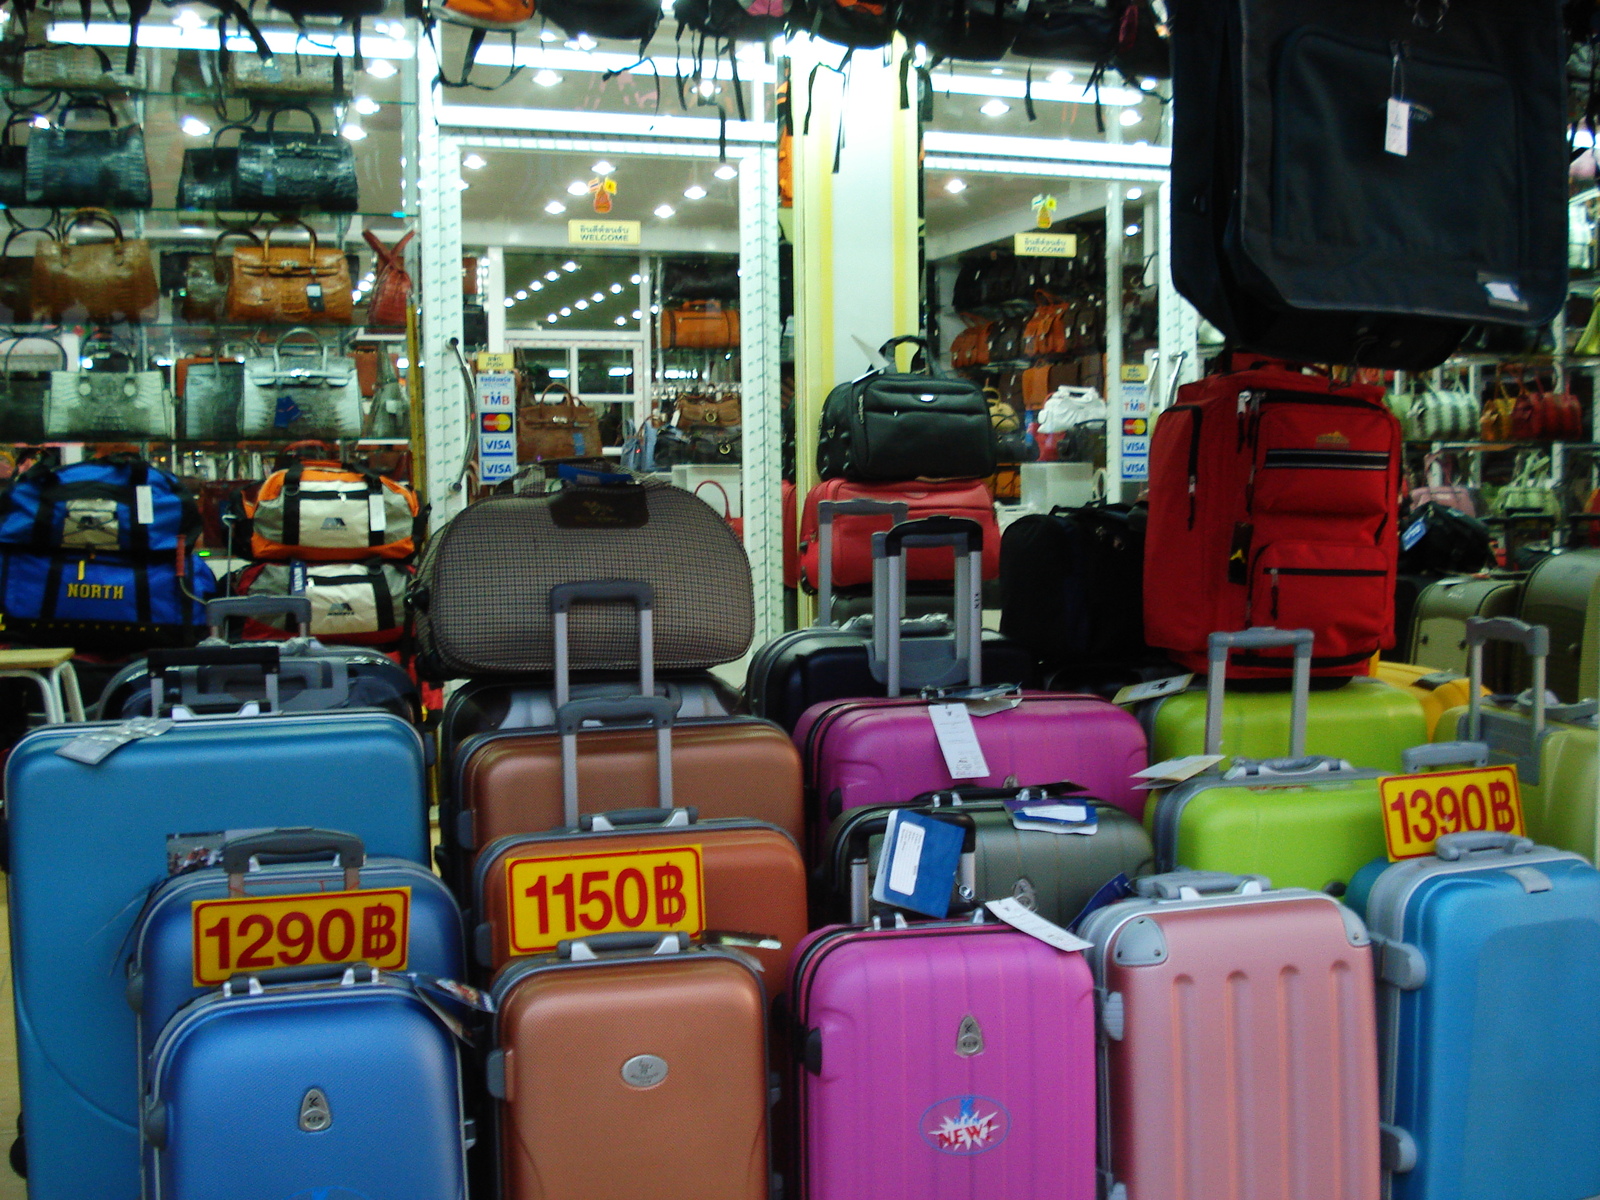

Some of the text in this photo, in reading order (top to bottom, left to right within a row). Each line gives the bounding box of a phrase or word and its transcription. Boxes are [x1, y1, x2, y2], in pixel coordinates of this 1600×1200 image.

[1025, 245, 1066, 253] WELCOME
[482, 395, 509, 405] TMB
[1124, 402, 1146, 411] TMB
[486, 440, 511, 449] VISA
[1126, 442, 1145, 451] VISA
[487, 464, 511, 474] VISA
[1126, 463, 1145, 472] VISA
[67, 583, 124, 600] NORTH
